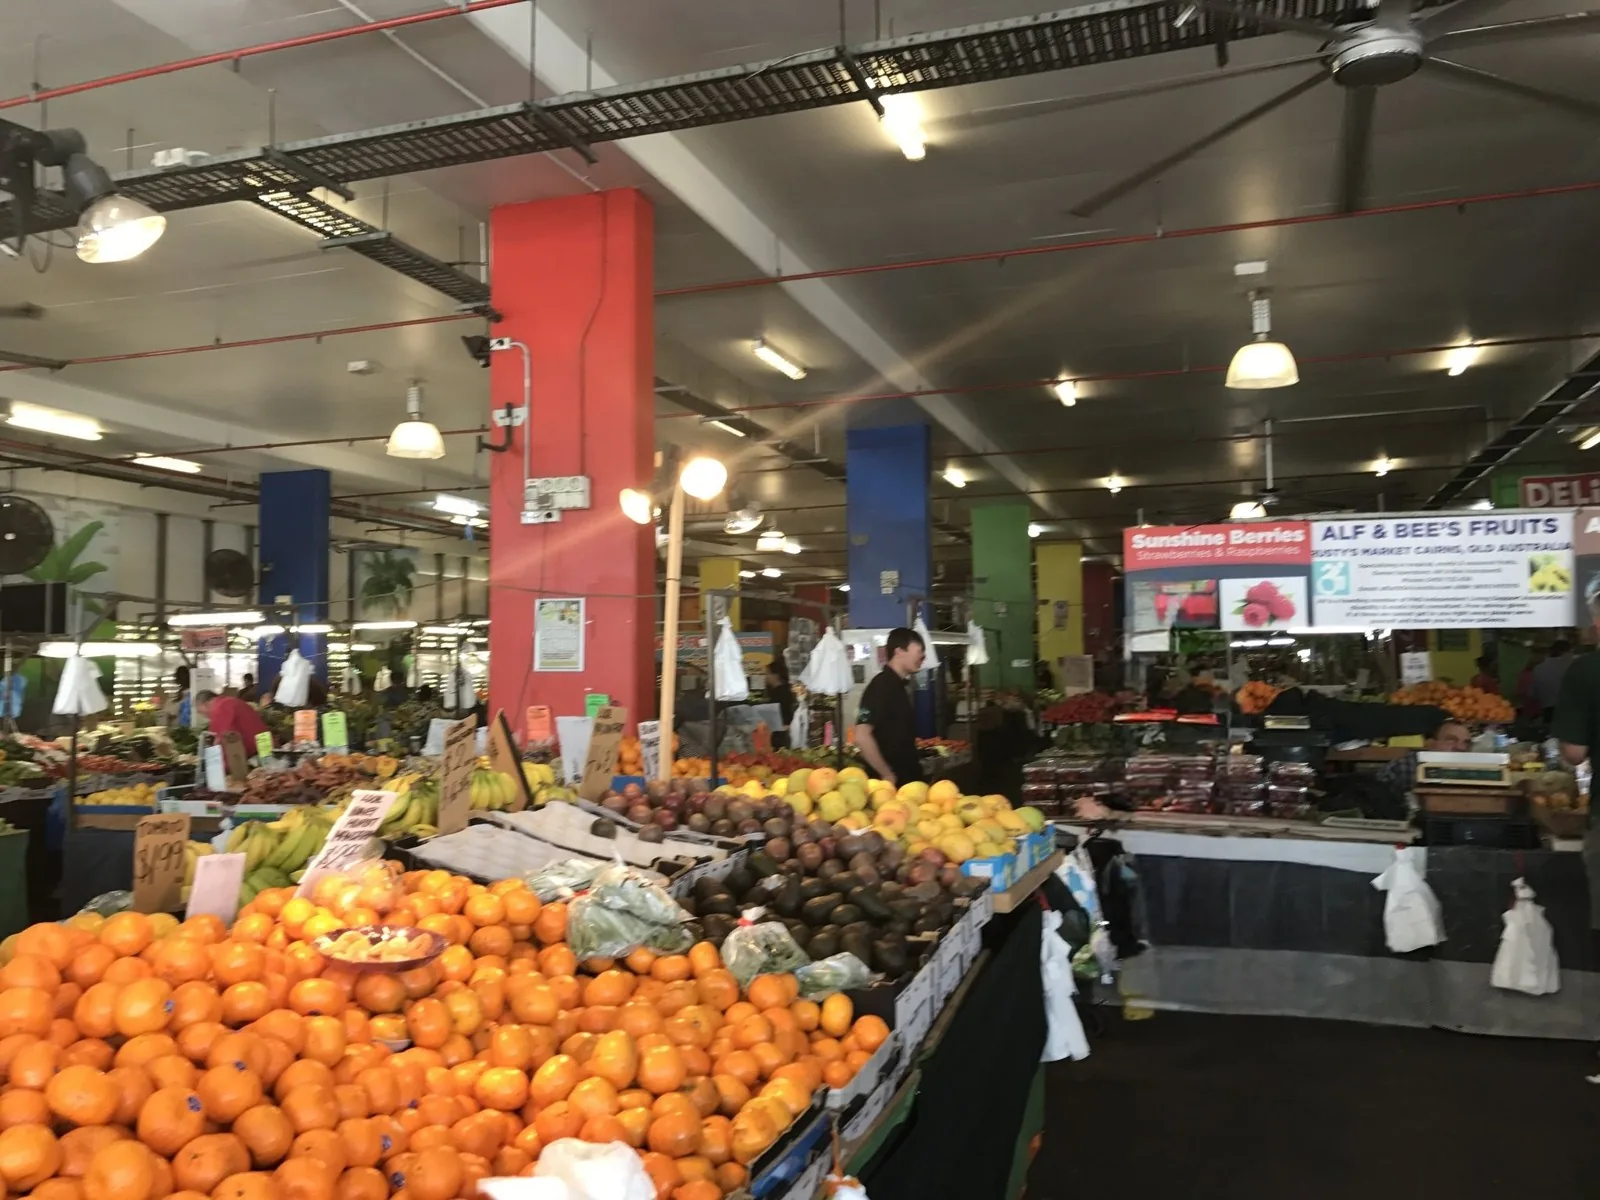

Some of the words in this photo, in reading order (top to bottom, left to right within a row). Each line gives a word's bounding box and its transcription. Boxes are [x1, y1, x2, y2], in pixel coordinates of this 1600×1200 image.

[1131, 531, 1225, 549] Sunshine
[1229, 528, 1306, 545] Berries
[1321, 524, 1366, 541] ALF
[1372, 523, 1388, 539] &
[1394, 521, 1462, 538] BEE'S
[1468, 517, 1559, 537] FRUITS
[1136, 549, 1211, 561] Strawberries
[1226, 544, 1302, 557] Raspberries
[1361, 546, 1411, 557] MARKET
